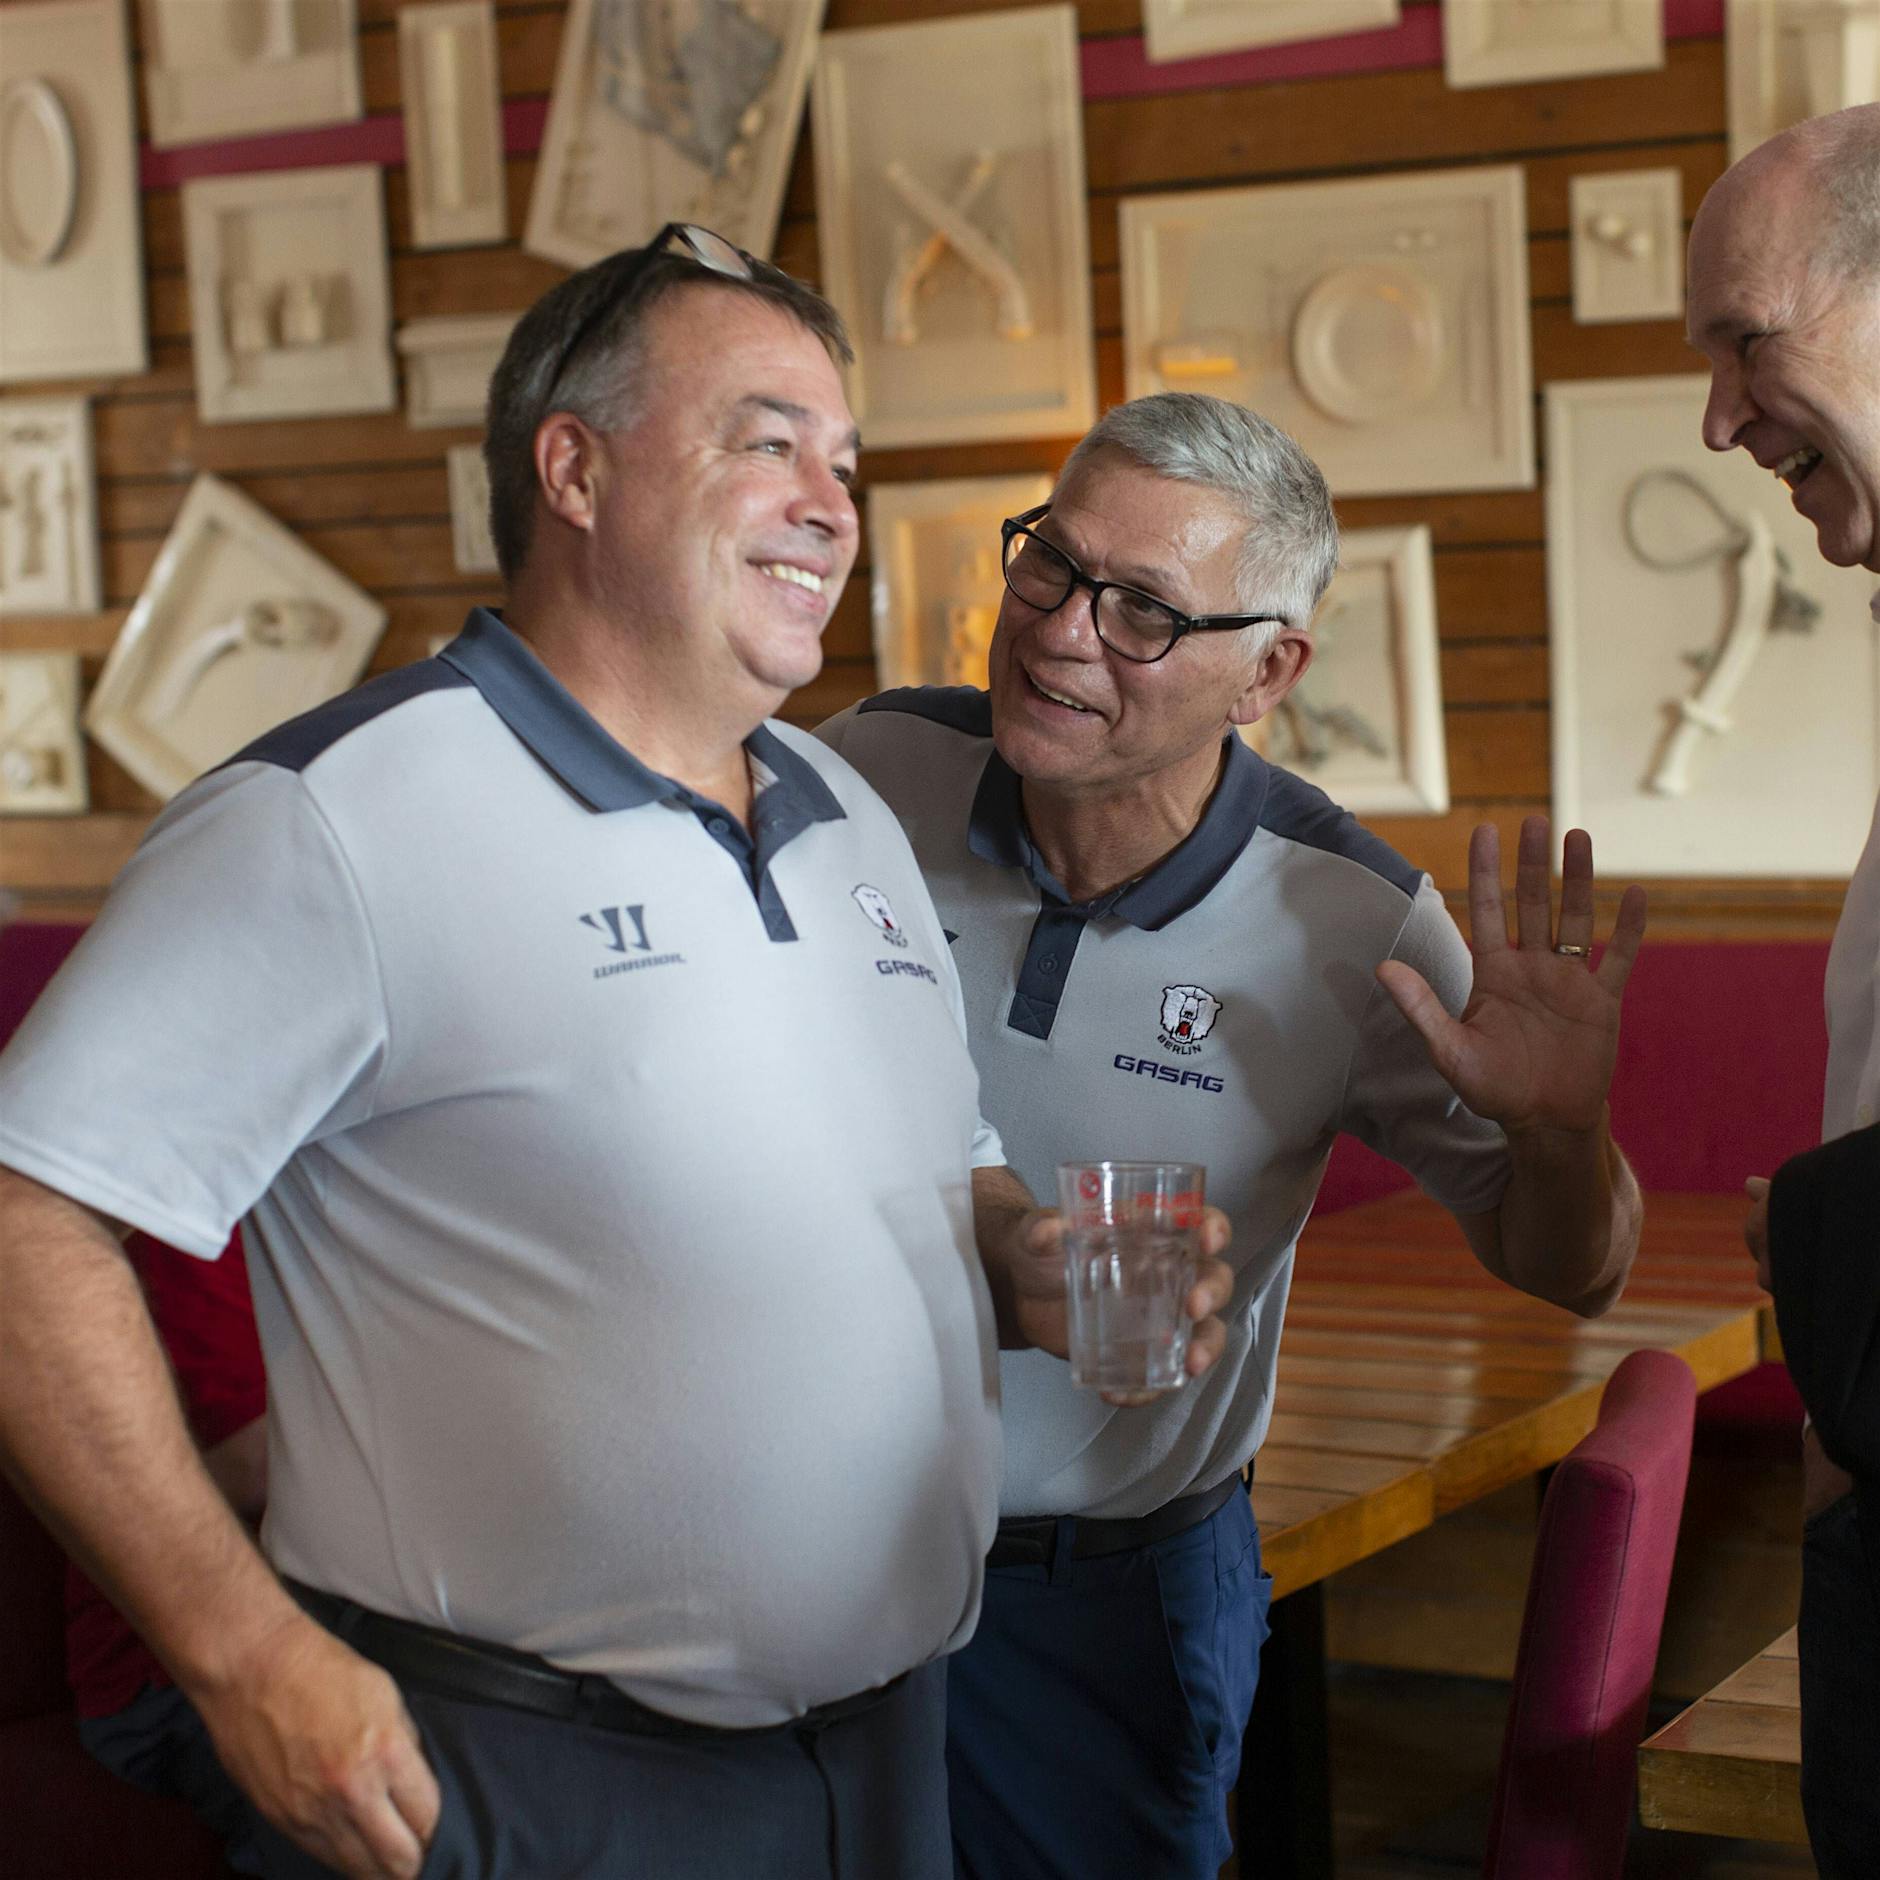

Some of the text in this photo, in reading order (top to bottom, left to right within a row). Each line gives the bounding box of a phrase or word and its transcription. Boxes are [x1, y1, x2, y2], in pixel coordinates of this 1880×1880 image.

[876, 960, 938, 985] GASAG
[1157, 1034, 1202, 1055] BERLIN
[1114, 1054, 1224, 1093] GASAG
